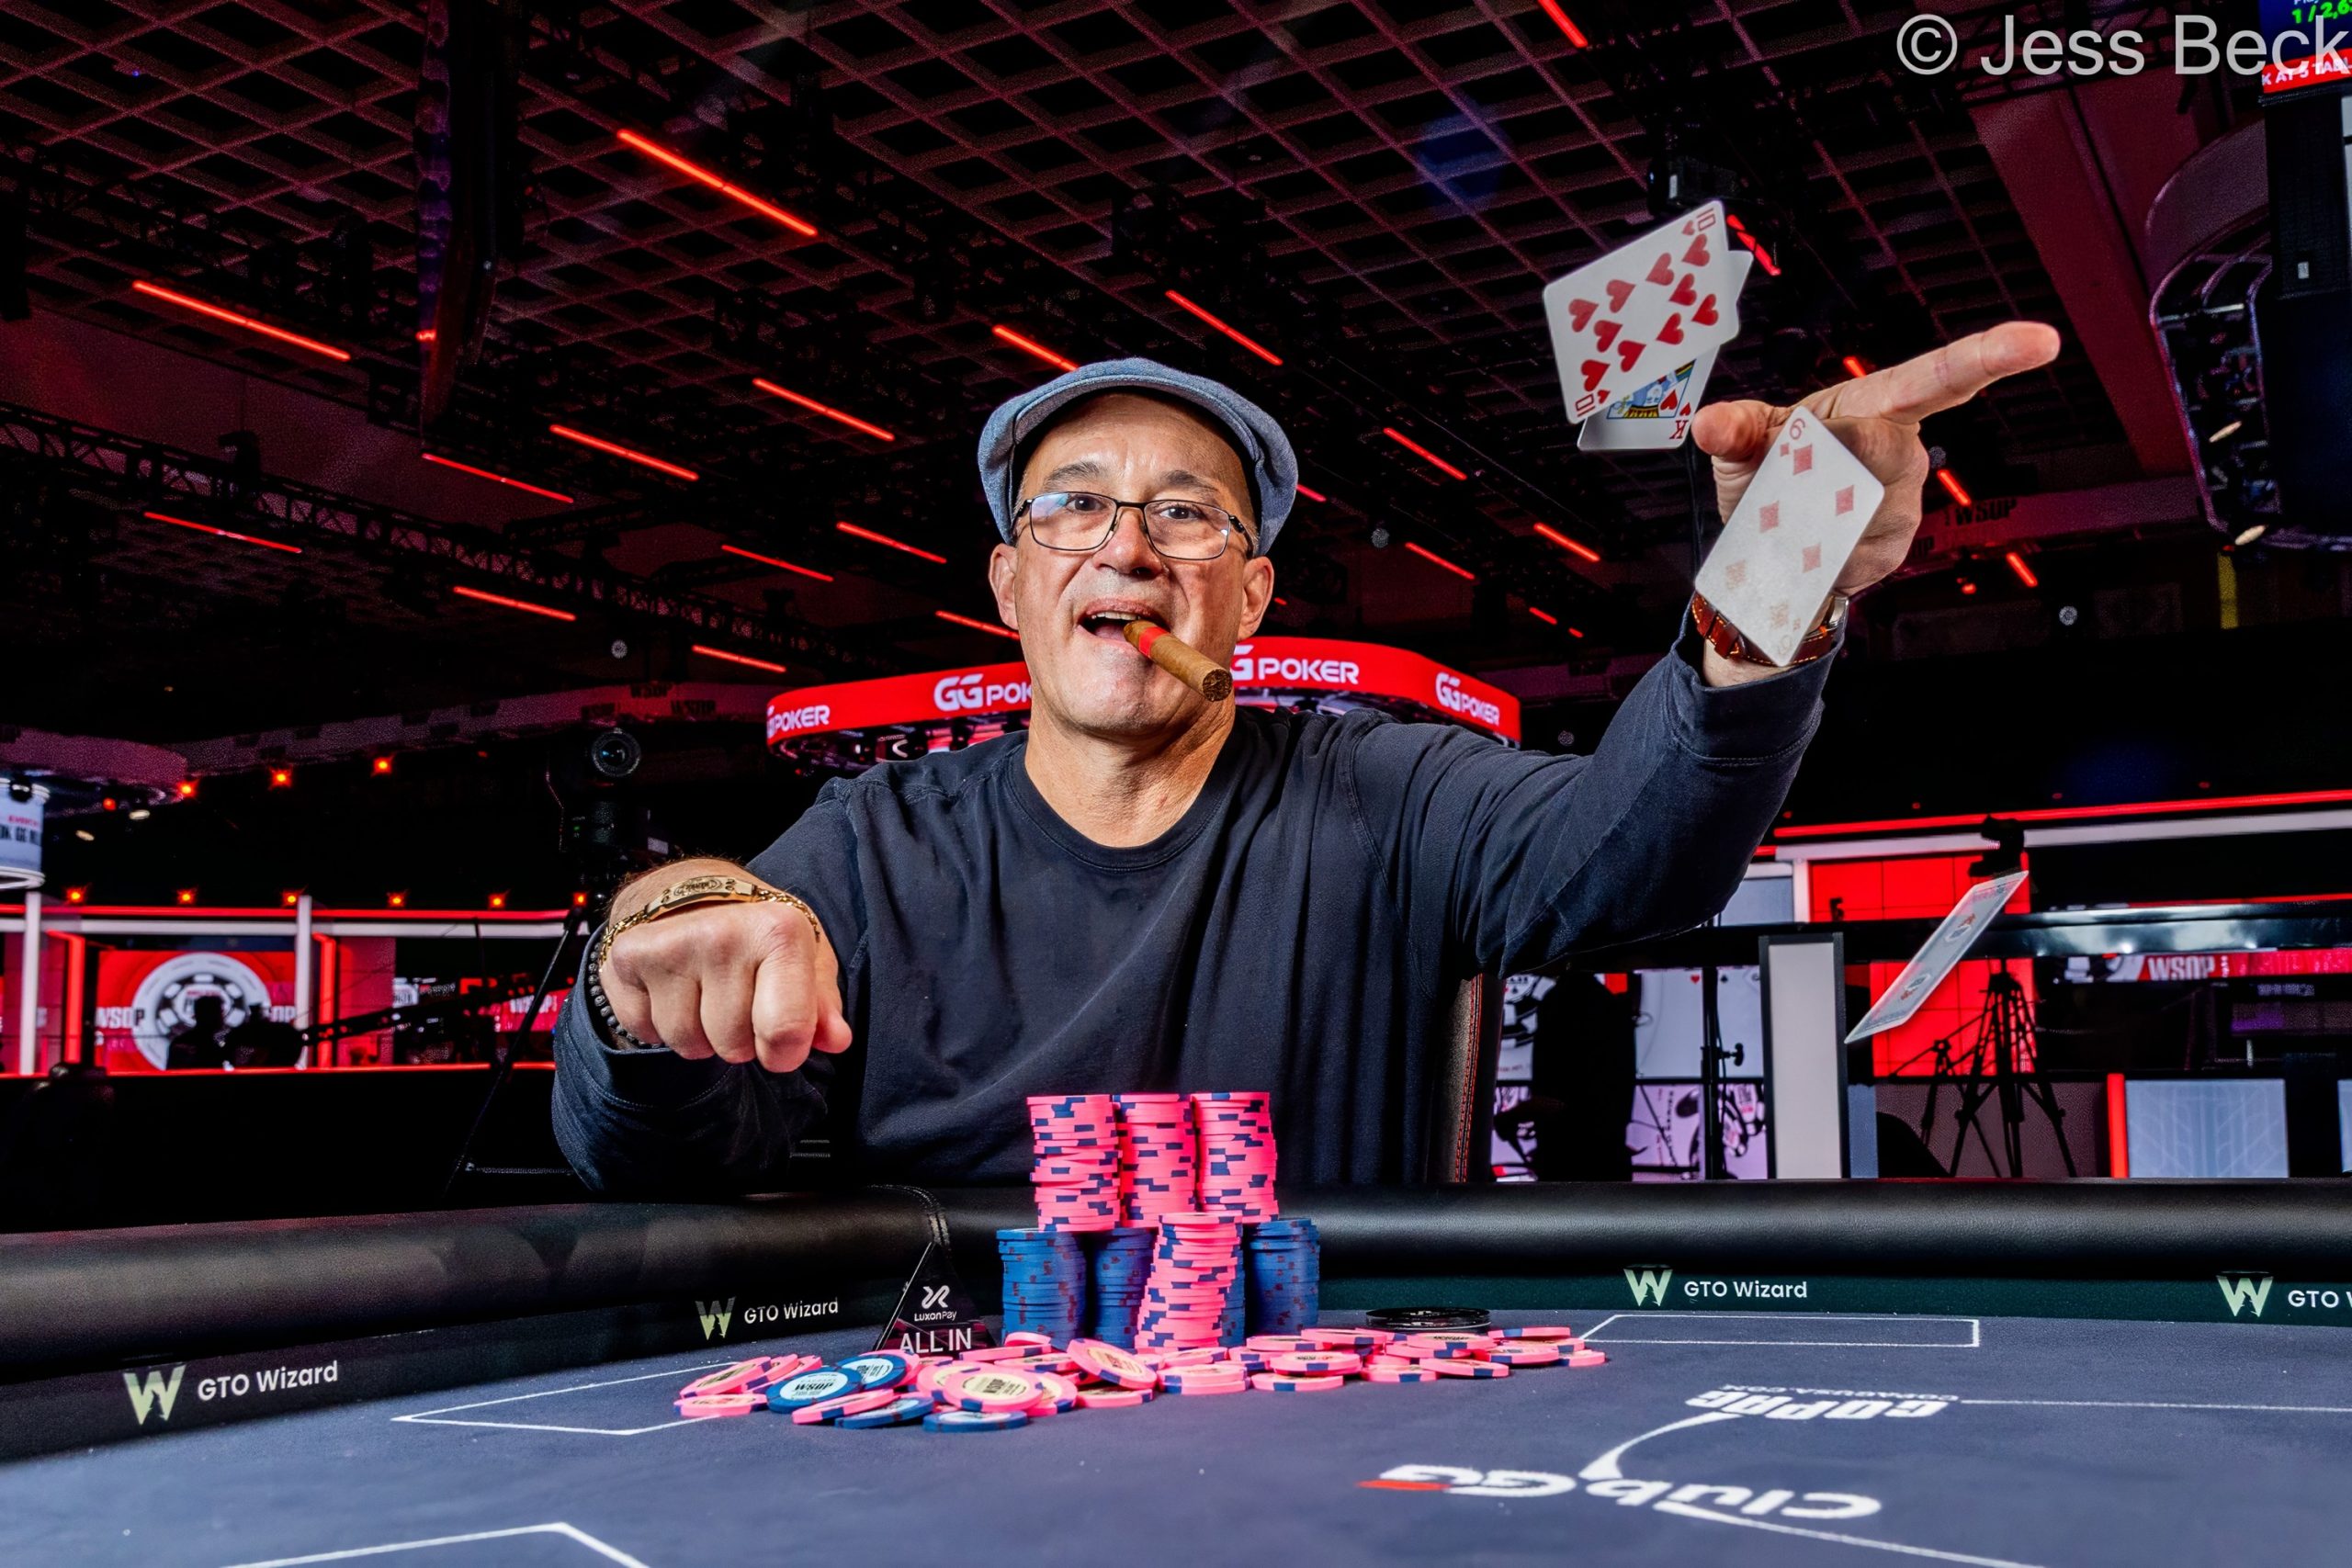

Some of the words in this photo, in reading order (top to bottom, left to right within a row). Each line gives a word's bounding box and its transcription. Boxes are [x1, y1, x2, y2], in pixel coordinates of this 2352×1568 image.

[1696, 208, 1716, 231] 10
[1668, 420, 1690, 440] K
[1789, 417, 1806, 441] 6
[1230, 645, 1360, 685] GPOKER
[2147, 955, 2216, 981] WSOP
[1683, 1280, 1728, 1298] GTO
[1733, 1280, 1808, 1299] Wizard
[2288, 1290, 2339, 1308] GTO
[743, 1304, 779, 1325] GTO
[783, 1296, 839, 1321] Wizard
[899, 1330, 944, 1355] ALL
[948, 1327, 972, 1351] IN
[198, 1373, 250, 1402] GTO
[255, 1359, 338, 1393] Wizard
